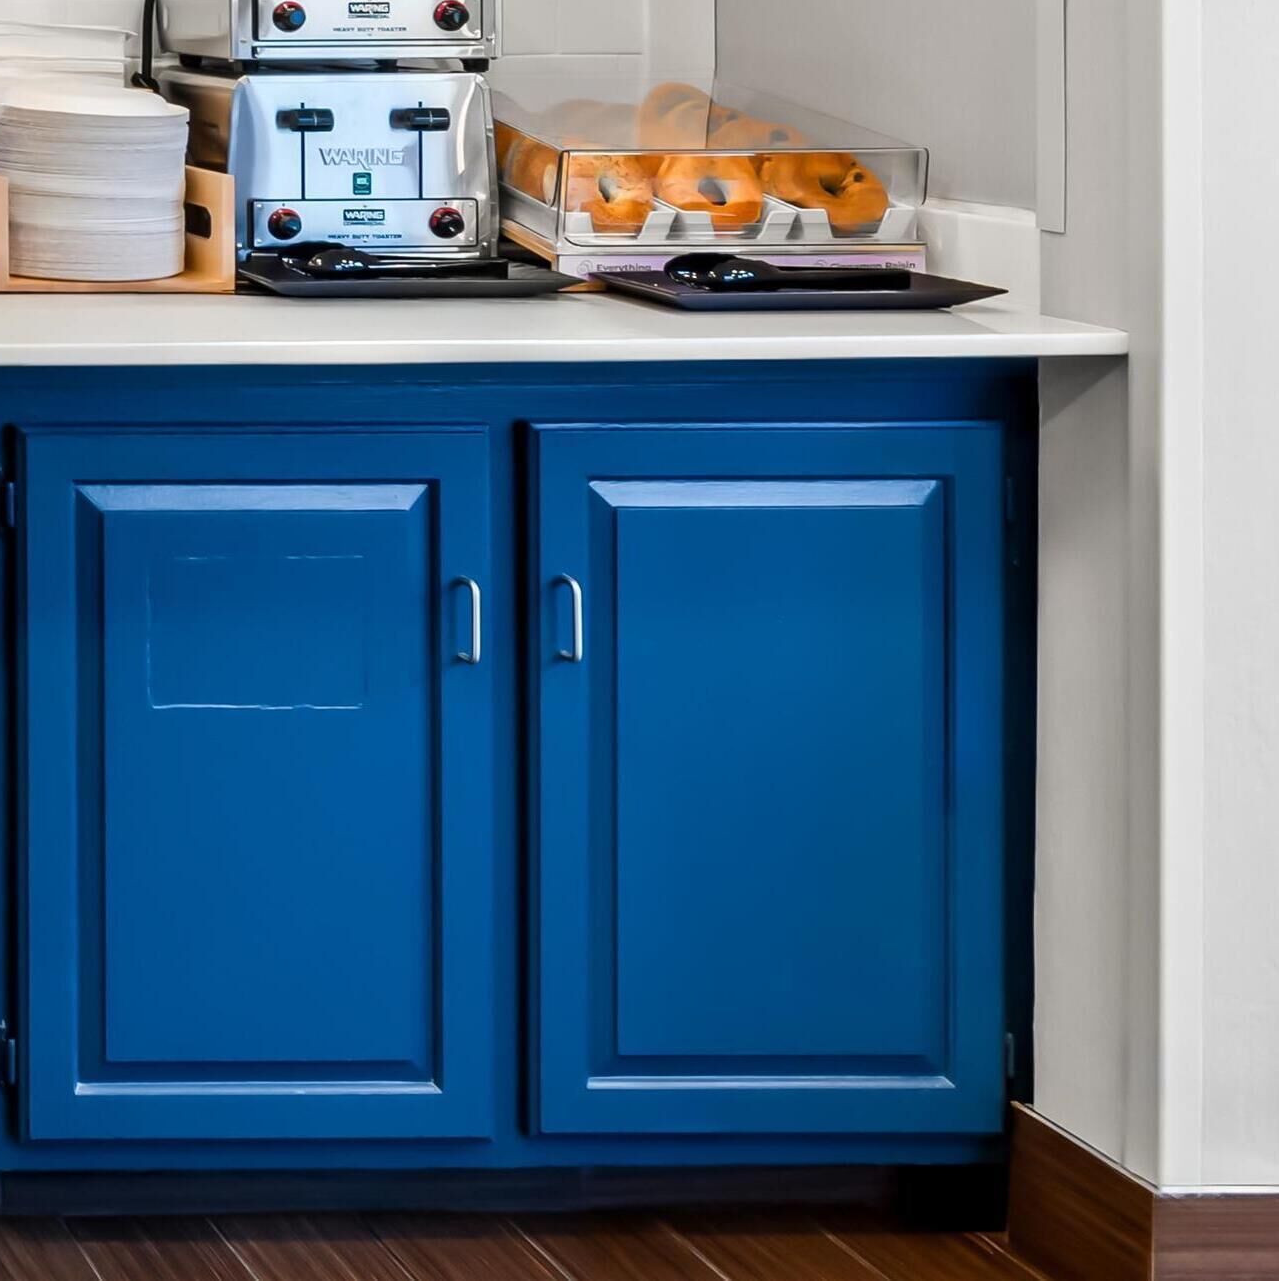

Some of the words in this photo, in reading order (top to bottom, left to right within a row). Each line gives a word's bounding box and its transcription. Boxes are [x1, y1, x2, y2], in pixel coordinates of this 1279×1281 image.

[350, 3, 389, 15] WARING
[318, 147, 404, 171] WARING
[345, 210, 384, 221] WARING
